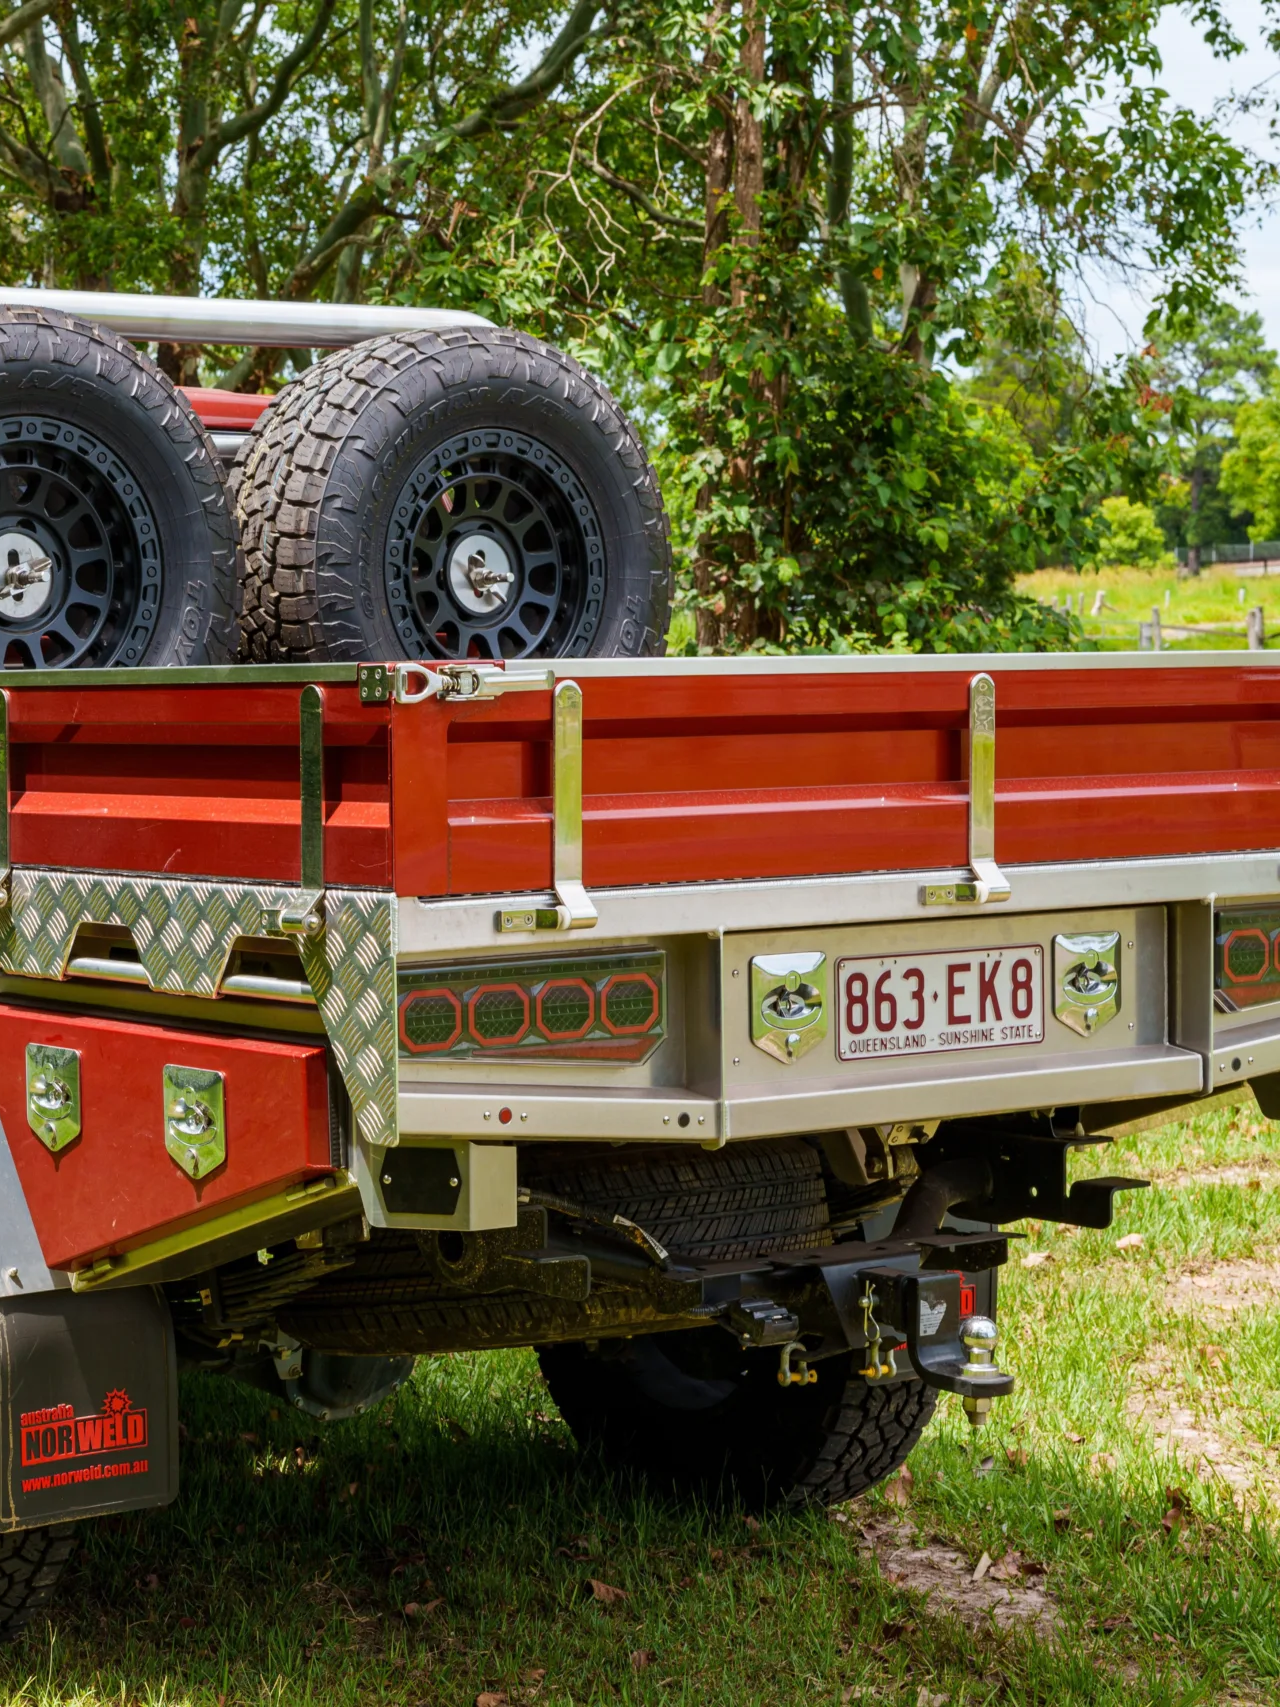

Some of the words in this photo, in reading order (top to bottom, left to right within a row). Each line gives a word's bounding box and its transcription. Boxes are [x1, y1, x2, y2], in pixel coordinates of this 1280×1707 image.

[167, 580, 207, 666] TOY
[849, 1029, 926, 1054] QUEENSLAND
[939, 1026, 995, 1046] SUNSHINE
[1001, 1024, 1034, 1040] STATE
[20, 1403, 74, 1427] australia
[25, 1413, 144, 1461] NORWELD
[21, 1459, 148, 1493] www.norweld.com.au
